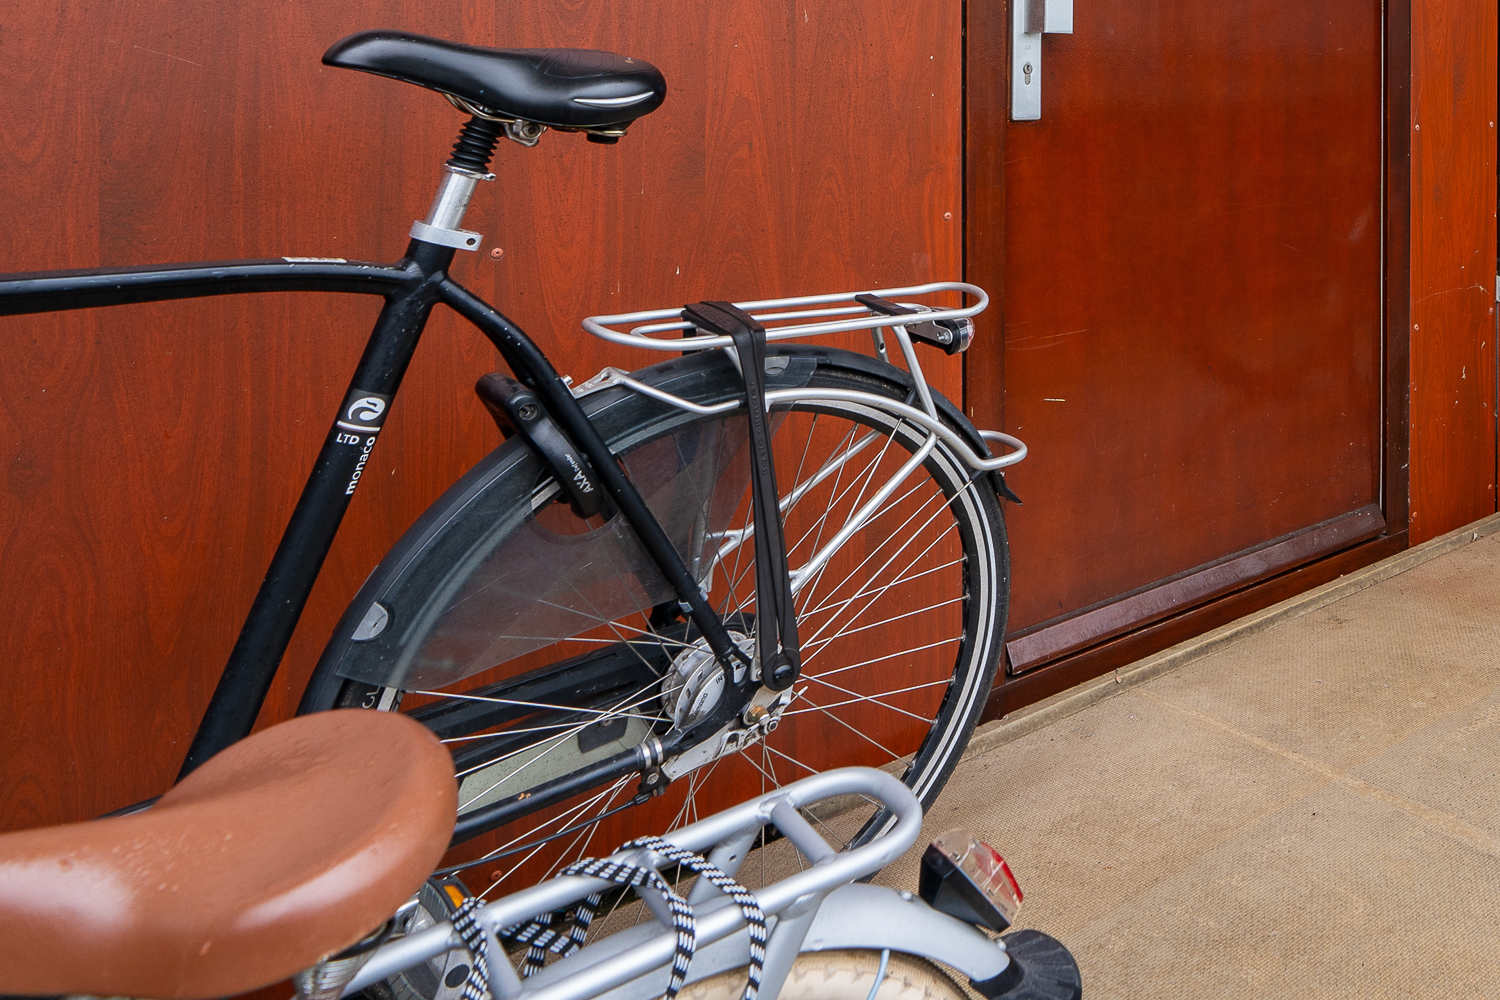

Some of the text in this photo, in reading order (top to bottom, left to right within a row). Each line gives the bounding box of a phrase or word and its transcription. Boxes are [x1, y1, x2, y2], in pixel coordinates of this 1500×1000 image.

[336, 433, 360, 445] LTD
[345, 436, 376, 495] monaco
[573, 470, 594, 493] AXA
